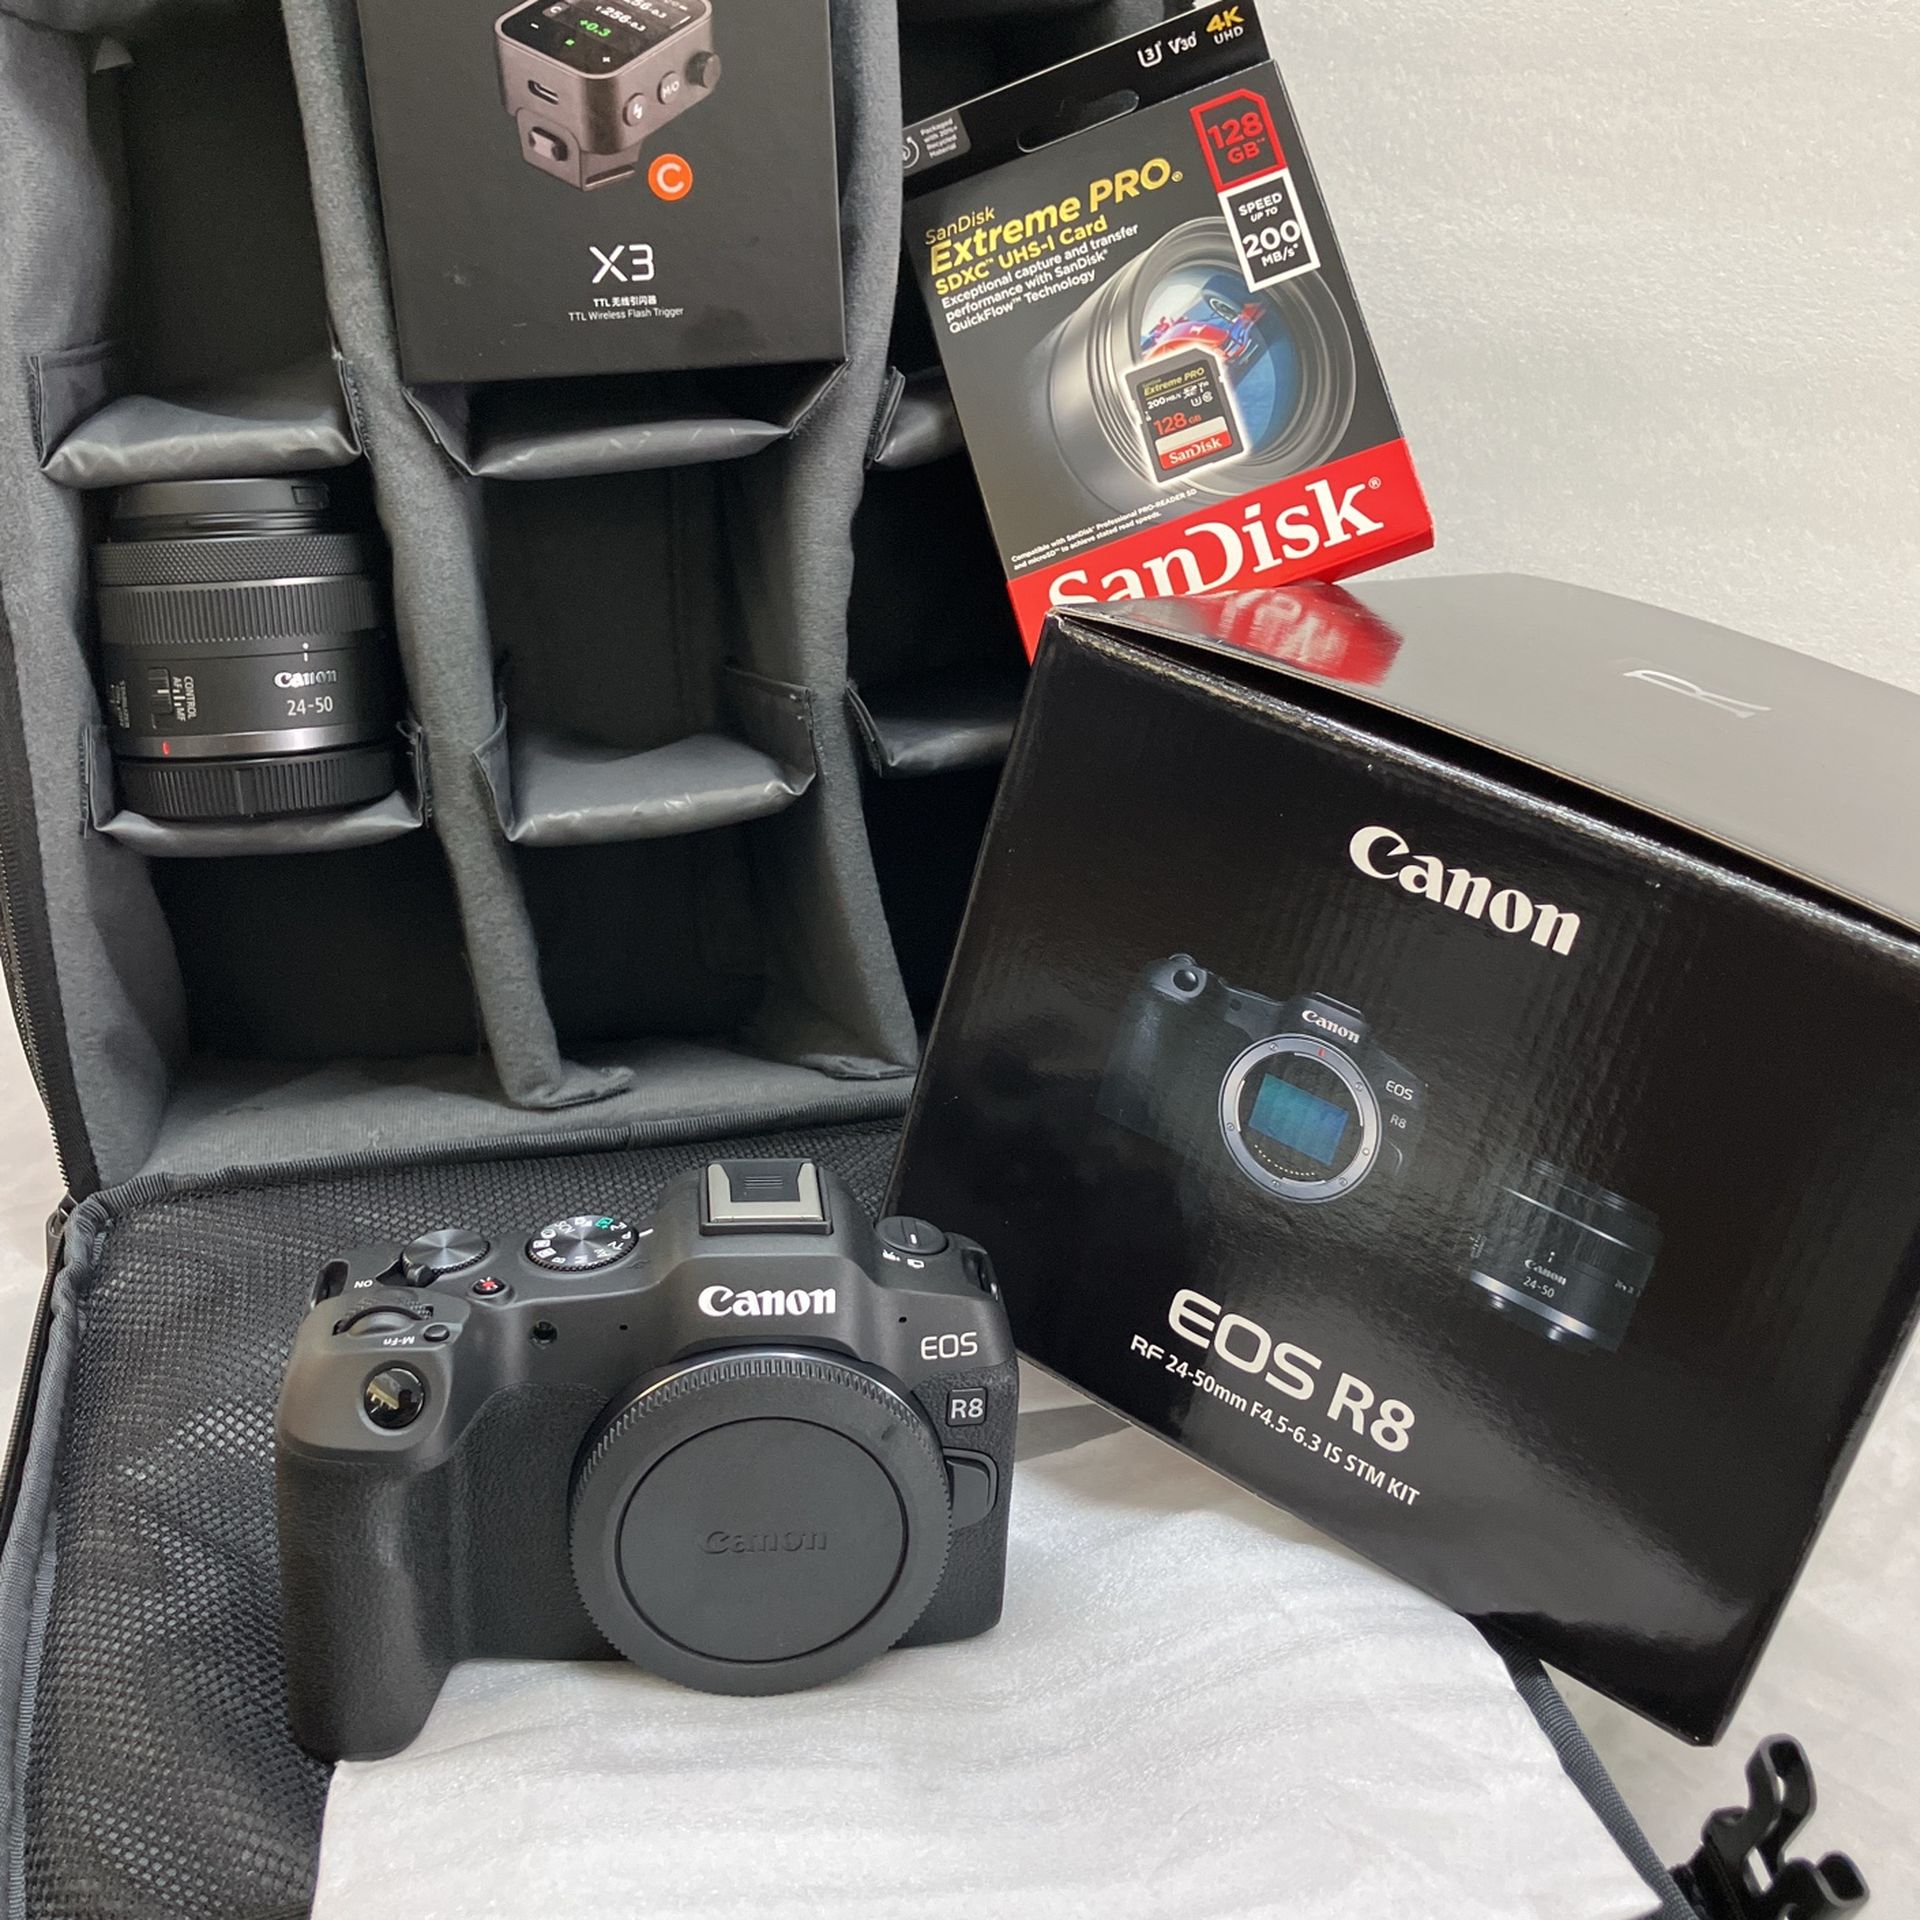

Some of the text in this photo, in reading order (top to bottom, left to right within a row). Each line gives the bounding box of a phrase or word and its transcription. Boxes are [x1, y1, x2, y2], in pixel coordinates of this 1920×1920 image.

[1206, 6, 1245, 33] 4K
[1213, 26, 1244, 45] UHD
[1206, 111, 1264, 150] 128
[656, 161, 685, 194] C
[1238, 192, 1283, 217] SPEED
[1250, 206, 1278, 223] UP TO
[925, 206, 995, 246] SanDisk
[931, 196, 1081, 276] Extreme
[1242, 219, 1301, 259] 200
[999, 235, 1055, 270] UHS-I
[1059, 215, 1108, 246] Card
[589, 244, 655, 283] X3
[941, 223, 1139, 309] Exceptional capture and transfer
[945, 284, 1023, 324] performance
[1025, 272, 1053, 292] with
[1023, 269, 1096, 305] Technology
[568, 307, 684, 321] TTL Wireless Flash Trigger
[593, 298, 611, 307] TTL
[1144, 376, 1182, 396] Extreme
[1184, 367, 1205, 381] PRO
[1147, 396, 1166, 410] 200
[1153, 412, 1187, 436] 128
[1168, 437, 1222, 464] SanDisk
[1011, 544, 1050, 562] Compatible
[1050, 537, 1067, 548] with
[1096, 509, 1138, 530] Professional
[1138, 492, 1186, 515] PRO-READER
[1186, 488, 1197, 498] SD
[1014, 560, 1027, 570] and
[1070, 534, 1096, 550] achieve
[1096, 525, 1119, 540] stated
[1119, 519, 1135, 531] read
[173, 677, 183, 689] AF
[273, 668, 337, 688] Canon
[184, 676, 197, 720] CONTROL
[287, 696, 333, 716] 24-50
[1349, 826, 1580, 956] Canon
[1302, 1010, 1360, 1044] Canon
[1385, 1080, 1414, 1101] EOS
[1390, 1114, 1407, 1129] R8
[353, 1279, 373, 1289] ON
[1524, 1259, 1567, 1286] Canon
[698, 1285, 836, 1316] Canon
[1523, 1276, 1555, 1298] 24-50
[383, 1335, 415, 1347] M-Fn
[921, 1331, 978, 1360] EOS
[1168, 1288, 1415, 1453] EOS R8
[951, 1397, 983, 1419] R8
[1130, 1334, 1420, 1506] RF 24-50mm F4.5-6.3 IS STM KIT
[704, 1530, 827, 1554] Canon
